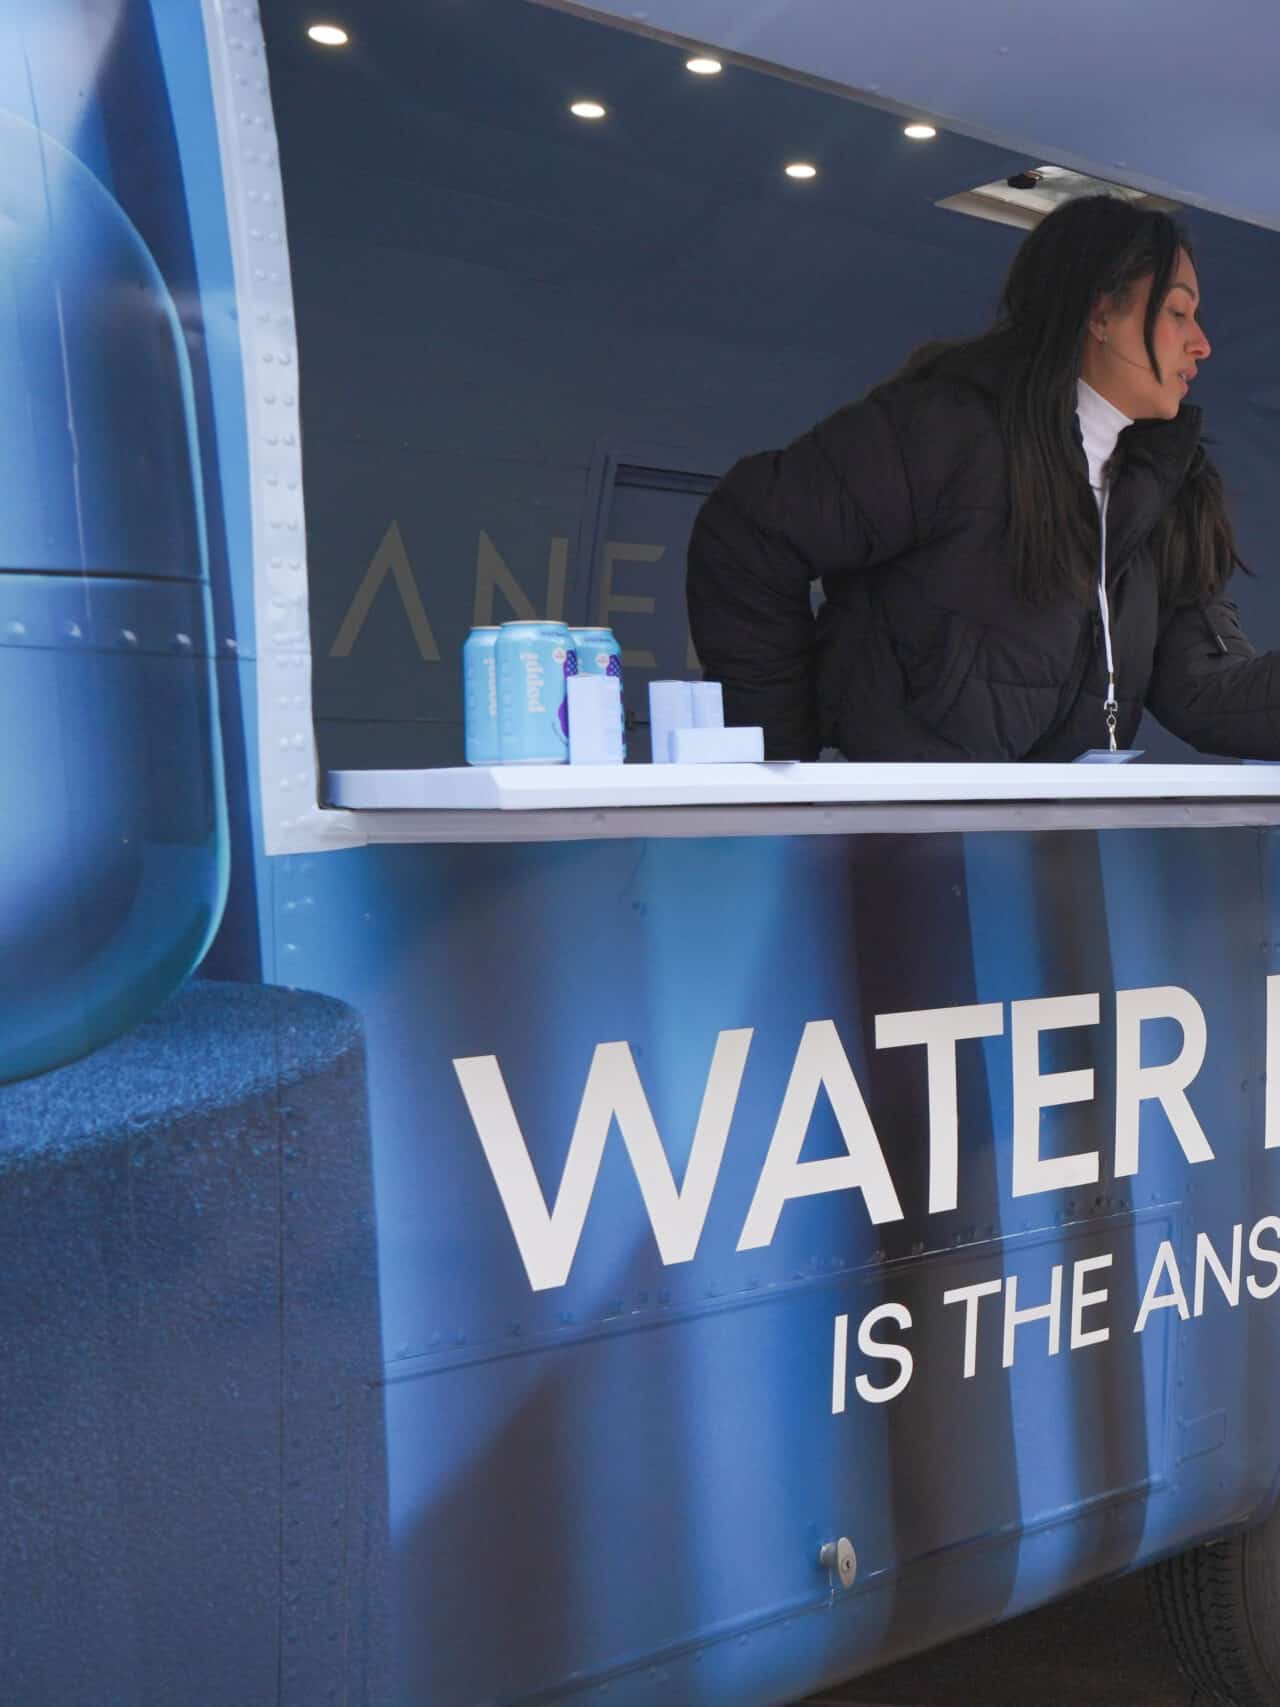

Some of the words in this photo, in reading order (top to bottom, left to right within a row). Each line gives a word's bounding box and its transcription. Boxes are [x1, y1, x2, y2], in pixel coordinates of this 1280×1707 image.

[452, 985, 1215, 1291] WATER
[831, 1302, 914, 1414] IS
[943, 1253, 1111, 1379] THE
